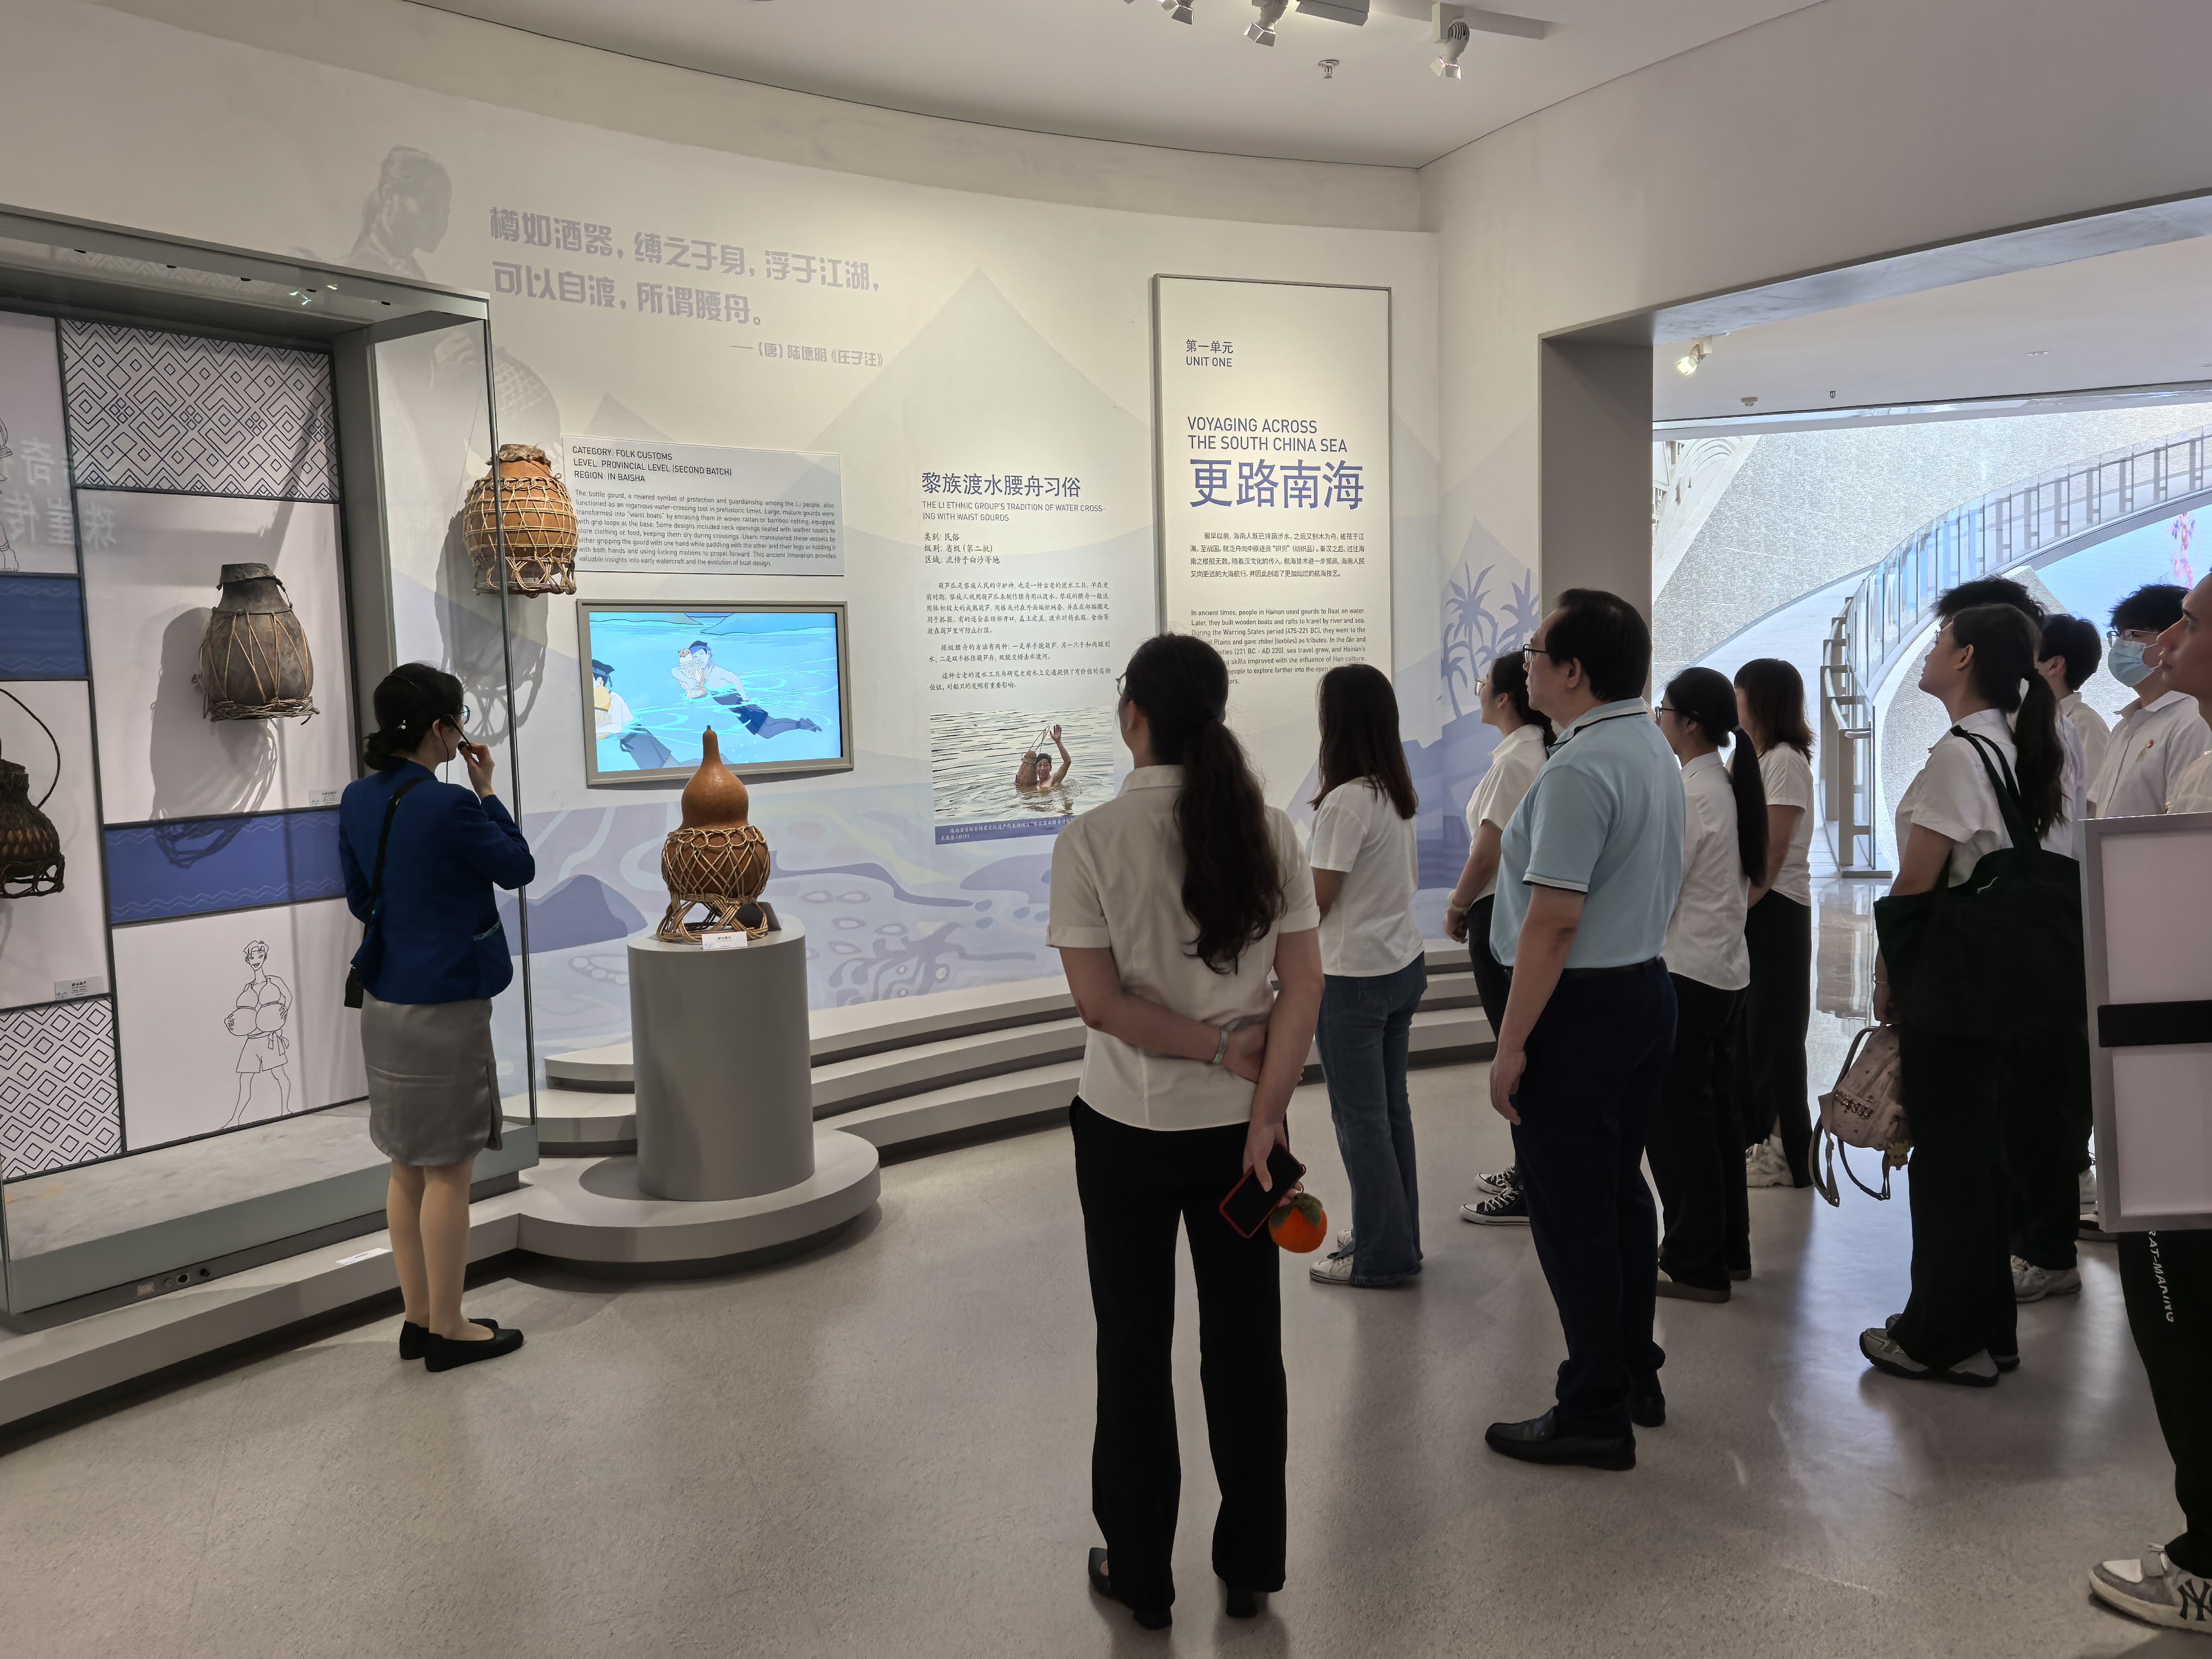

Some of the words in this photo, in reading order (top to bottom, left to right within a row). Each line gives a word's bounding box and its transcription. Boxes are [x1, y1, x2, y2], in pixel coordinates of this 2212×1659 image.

[1186, 339, 1233, 353] 第一单元
[1186, 356, 1209, 366] UNIT
[1212, 358, 1232, 367] ONE
[1188, 416, 1257, 432] VOYAGING
[1262, 419, 1317, 434] ACROSS
[1188, 435, 1216, 449] THE
[1221, 436, 1267, 450] SOUTH
[1273, 437, 1316, 451] CHINA
[1321, 439, 1347, 453] SEA
[573, 446, 613, 456] CATEGORY:
[637, 451, 672, 460] CUSTOMS
[602, 460, 646, 470] PROVINCIAL
[648, 463, 670, 471] LEVEL
[673, 465, 704, 473] (SECOND
[706, 468, 731, 476] BATCH)
[618, 474, 645, 482] BAISHA
[921, 472, 1081, 497] 黎族渡水腰舟习俗
[1189, 457, 1364, 510] 更路南海
[1007, 503, 1043, 511] TRADITION
